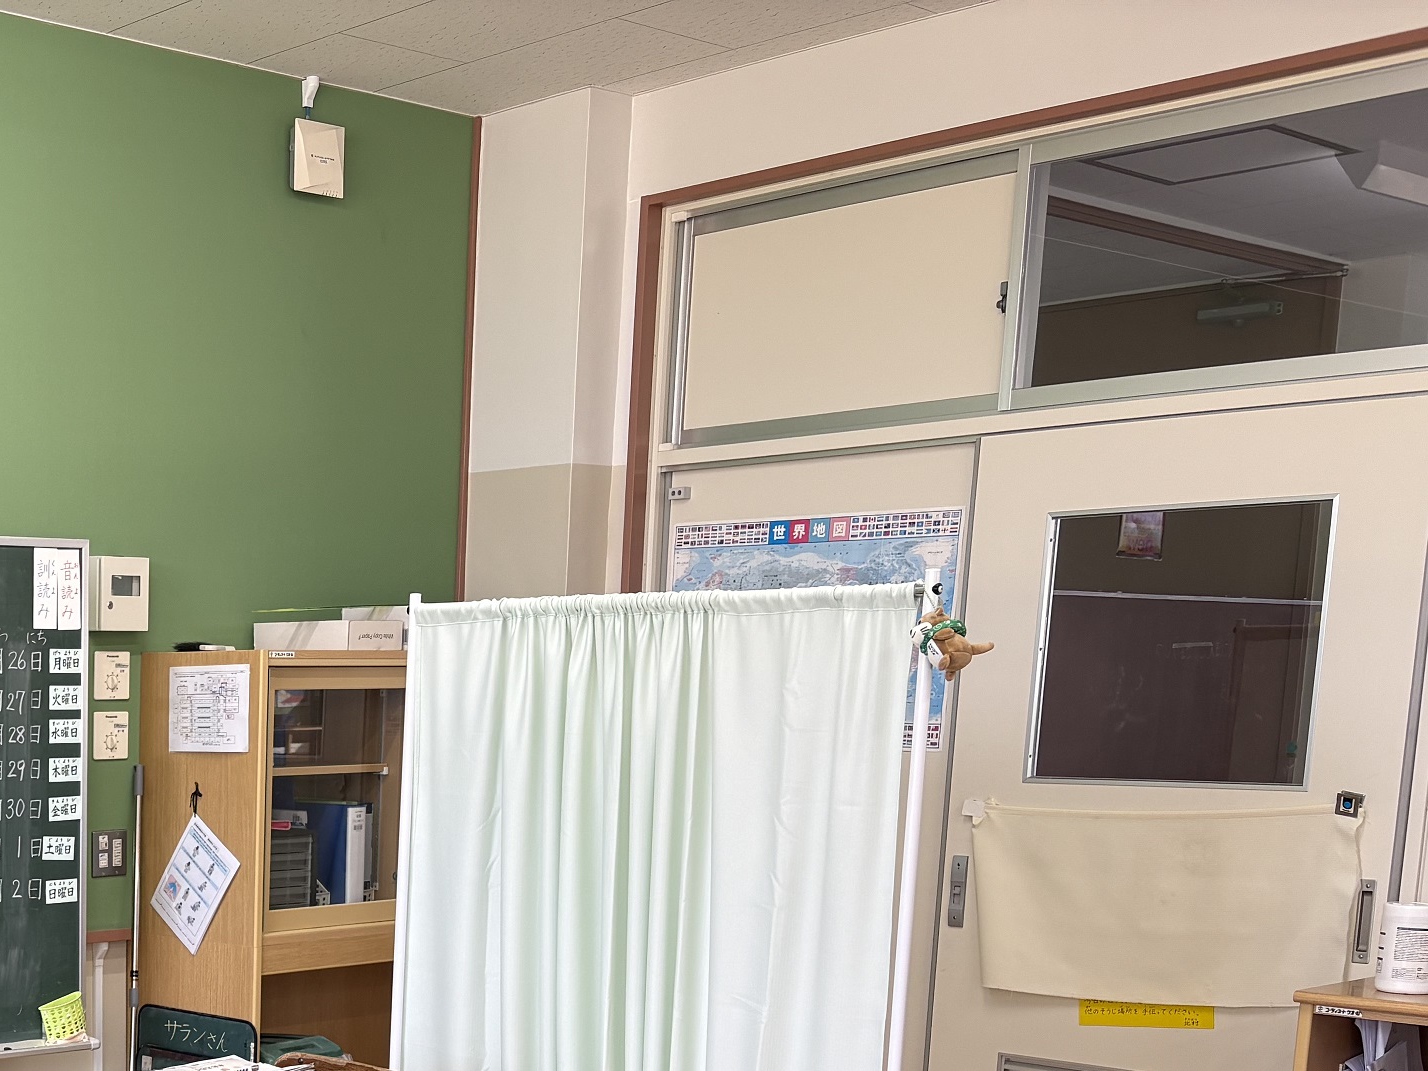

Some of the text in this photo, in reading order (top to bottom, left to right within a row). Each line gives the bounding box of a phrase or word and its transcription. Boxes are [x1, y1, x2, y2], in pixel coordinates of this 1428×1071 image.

[772, 521, 847, 541] 世界地図
[26, 630, 47, 646] にち
[52, 657, 79, 671] 月曜日
[52, 693, 78, 706] 火曜日
[51, 727, 78, 740] 水曜日
[51, 765, 78, 778] 木曜日
[50, 804, 77, 818] 金曜日
[44, 843, 72, 856] 土曜日
[48, 887, 74, 900] 日曜日
[163, 1019, 228, 1053] サランさん
